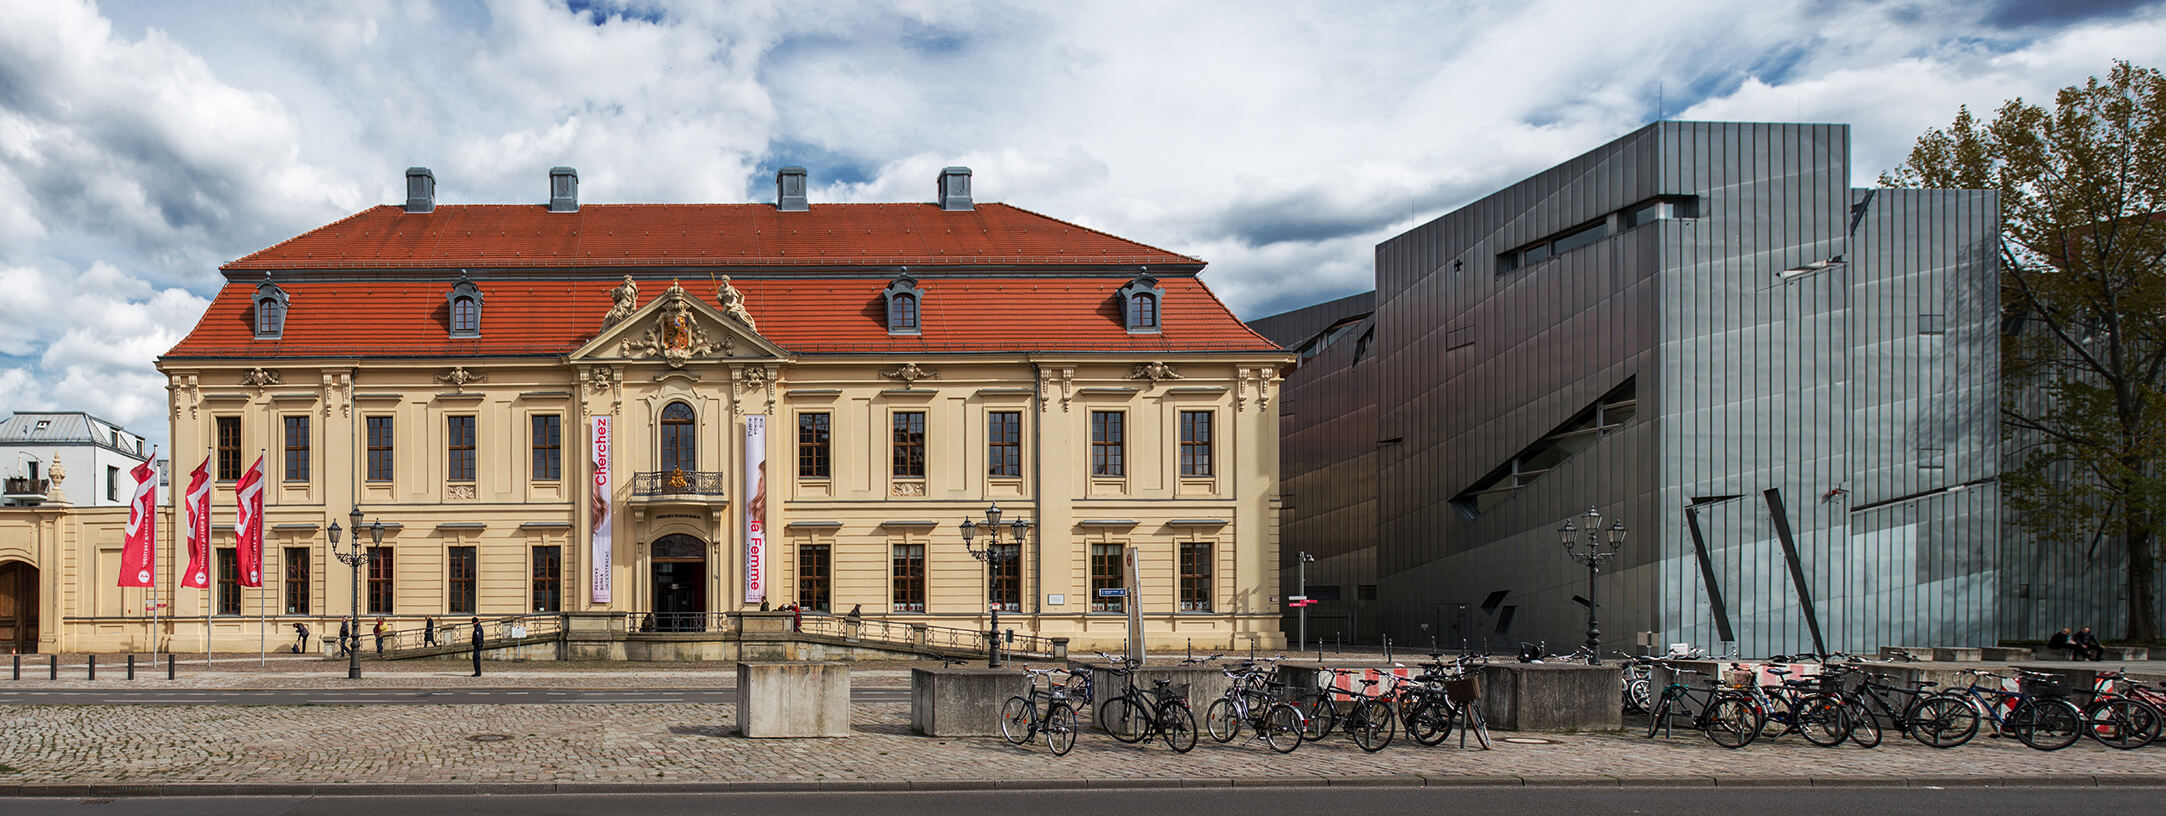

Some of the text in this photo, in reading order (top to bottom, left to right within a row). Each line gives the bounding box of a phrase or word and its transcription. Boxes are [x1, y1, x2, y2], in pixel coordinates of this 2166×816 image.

[595, 418, 606, 486] Cherchez
[751, 520, 762, 532] la
[751, 537, 761, 590] Femme
